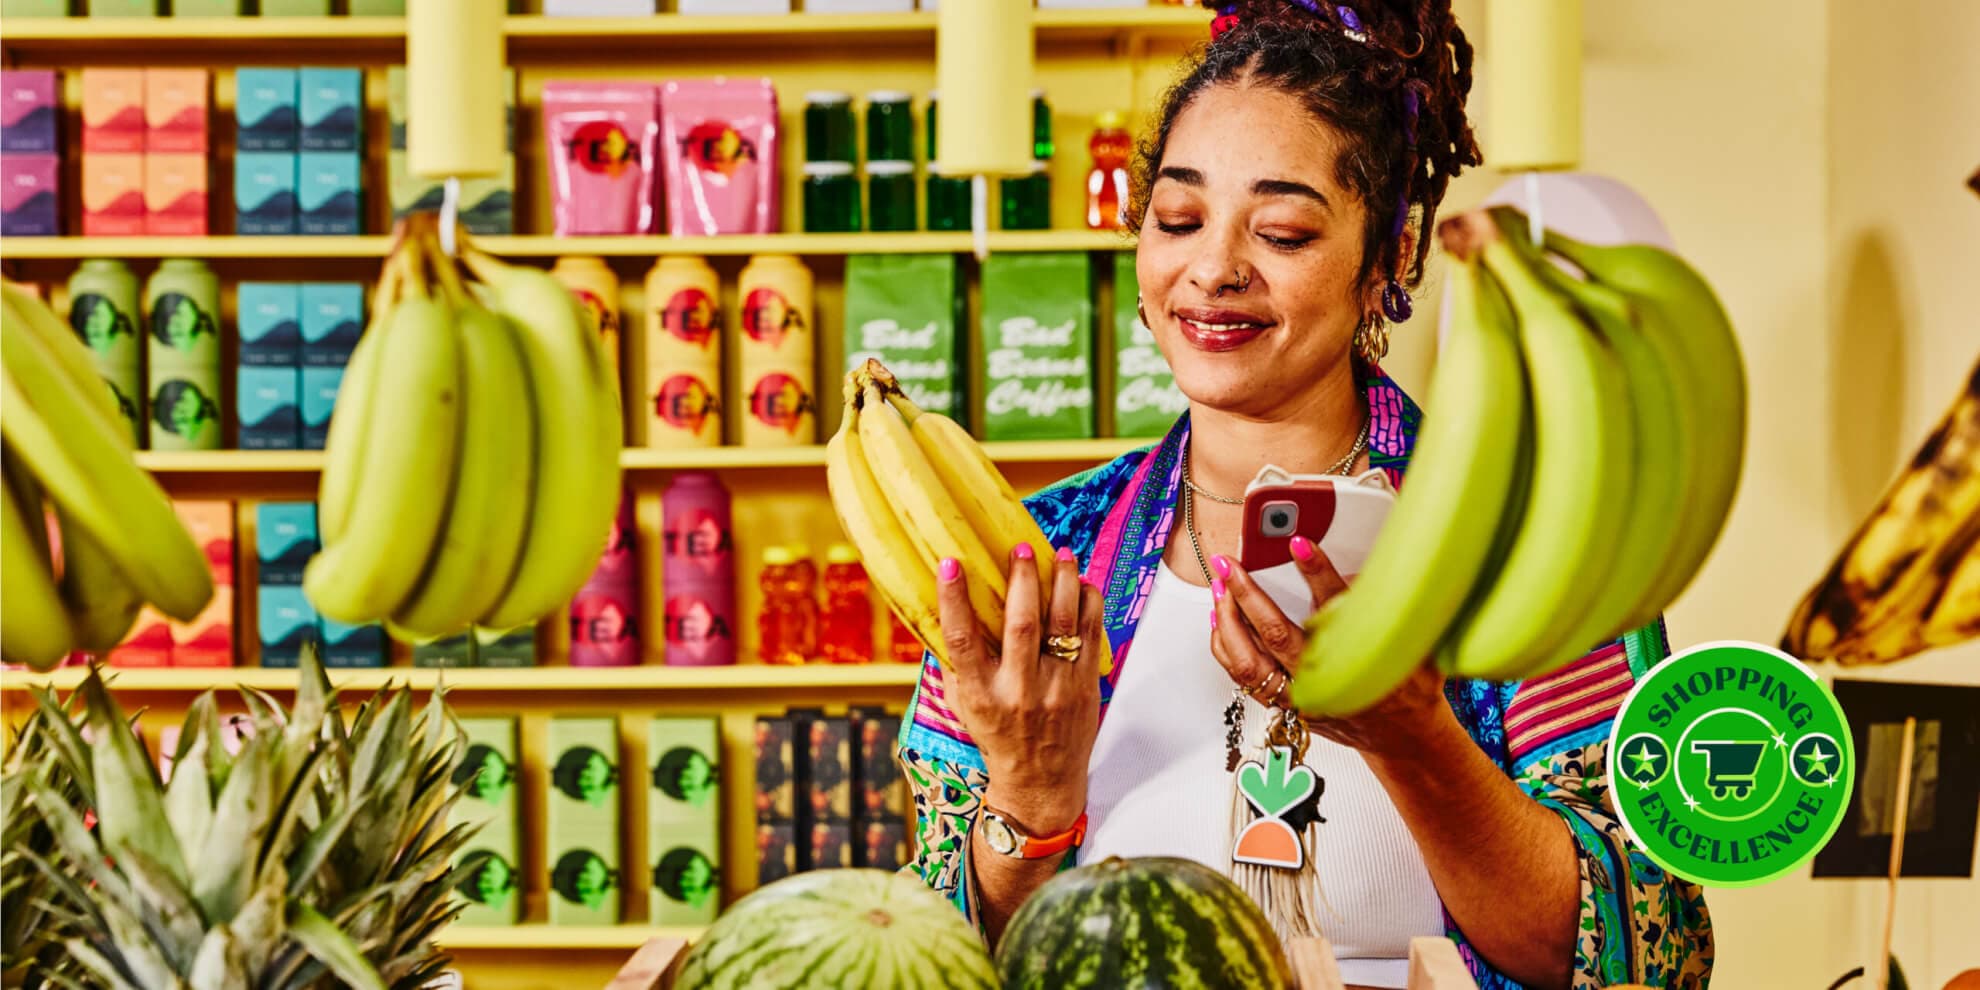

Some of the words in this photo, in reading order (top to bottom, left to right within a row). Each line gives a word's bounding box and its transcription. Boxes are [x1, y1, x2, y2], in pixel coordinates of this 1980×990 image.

[567, 138, 643, 167] TEA
[678, 137, 758, 163] TEA
[862, 319, 938, 349] Bad
[1001, 316, 1076, 347] Bad
[988, 349, 1086, 379] Beans
[647, 392, 722, 419] TEA
[743, 392, 817, 418] TEA
[986, 379, 1091, 417] Coffee
